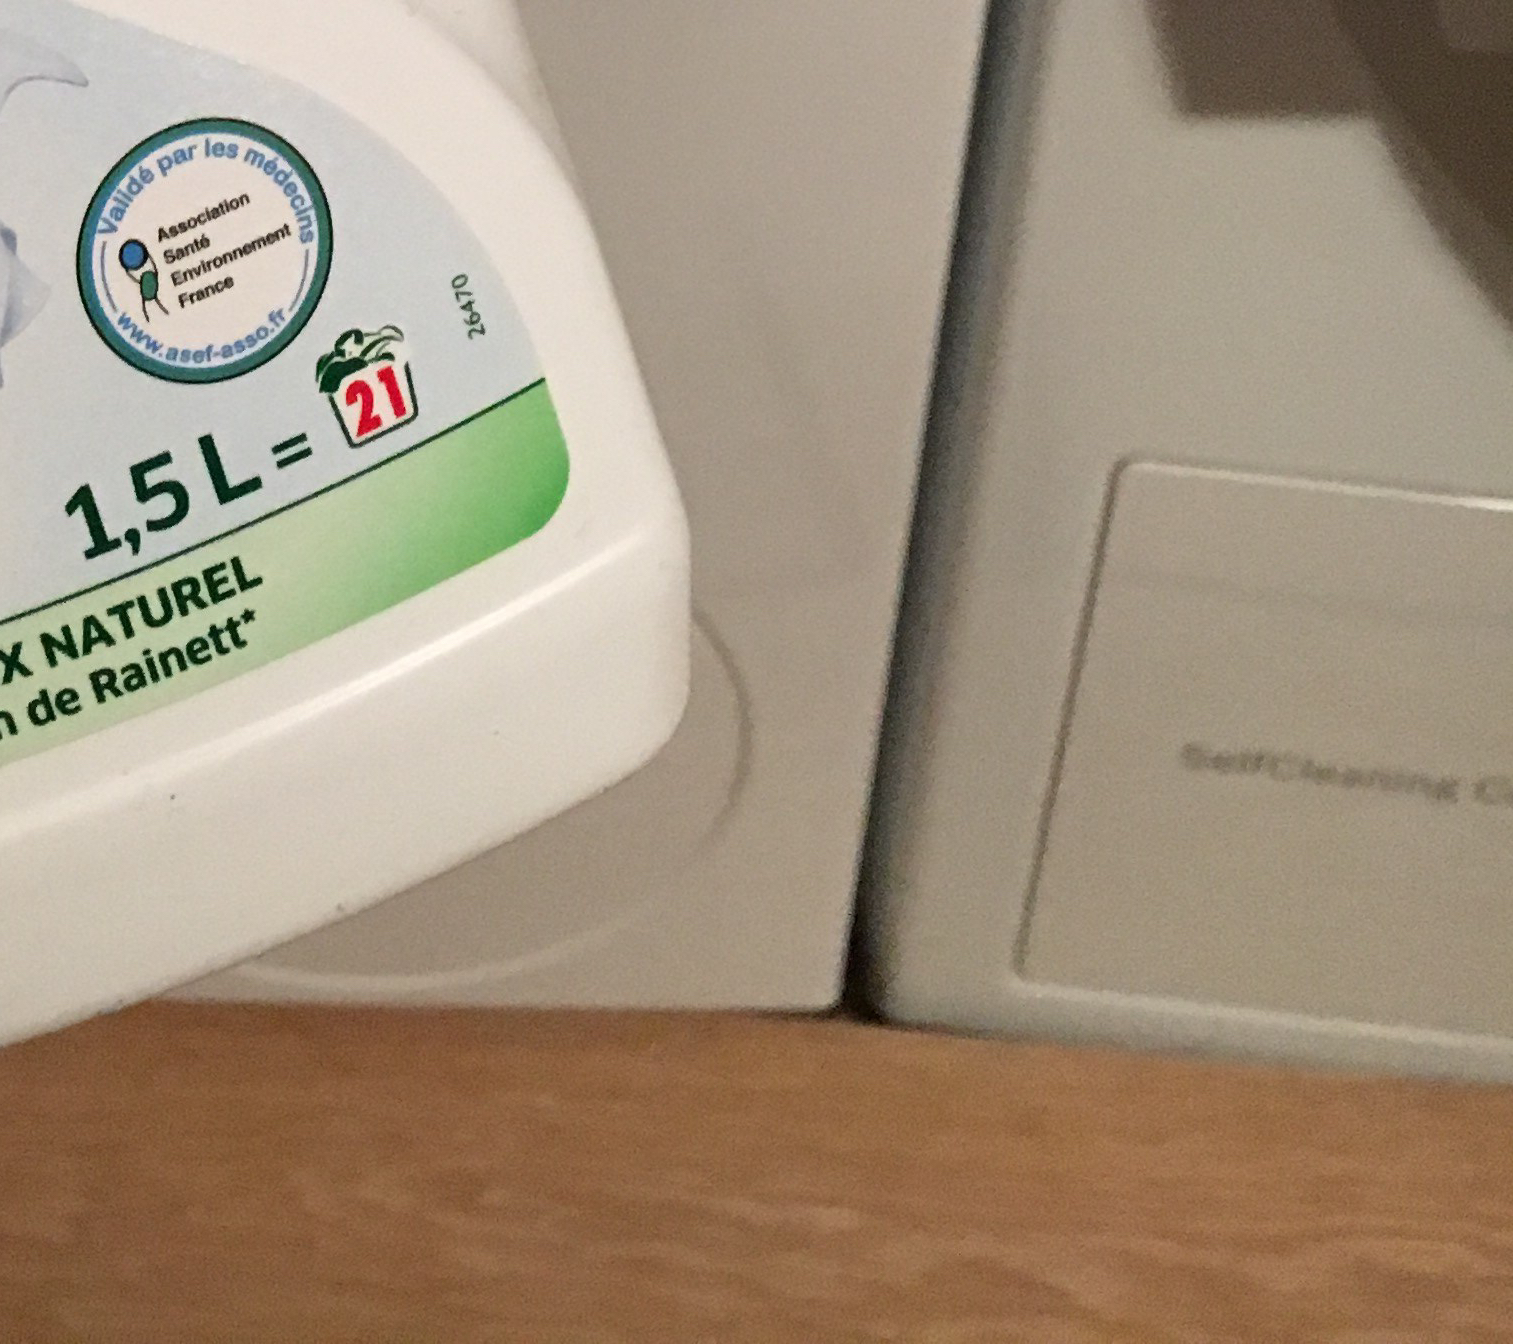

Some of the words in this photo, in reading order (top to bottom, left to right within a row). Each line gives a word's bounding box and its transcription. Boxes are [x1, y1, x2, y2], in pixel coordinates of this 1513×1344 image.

[97, 166, 155, 234] Validé
[156, 144, 197, 177] par
[204, 137, 239, 160] les
[243, 148, 315, 244] médecins
[157, 192, 251, 243] Association
[162, 233, 211, 265] Santé
[169, 223, 292, 287] Environnement
[177, 275, 235, 308] France
[451, 273, 486, 339] 26470
[117, 308, 286, 364] www.asef-asso.fr
[64, 450, 190, 560] 1,5
[198, 433, 263, 506] L
[345, 365, 408, 438] 21
[39, 555, 264, 669] NATUREL
[27, 683, 83, 727] de
